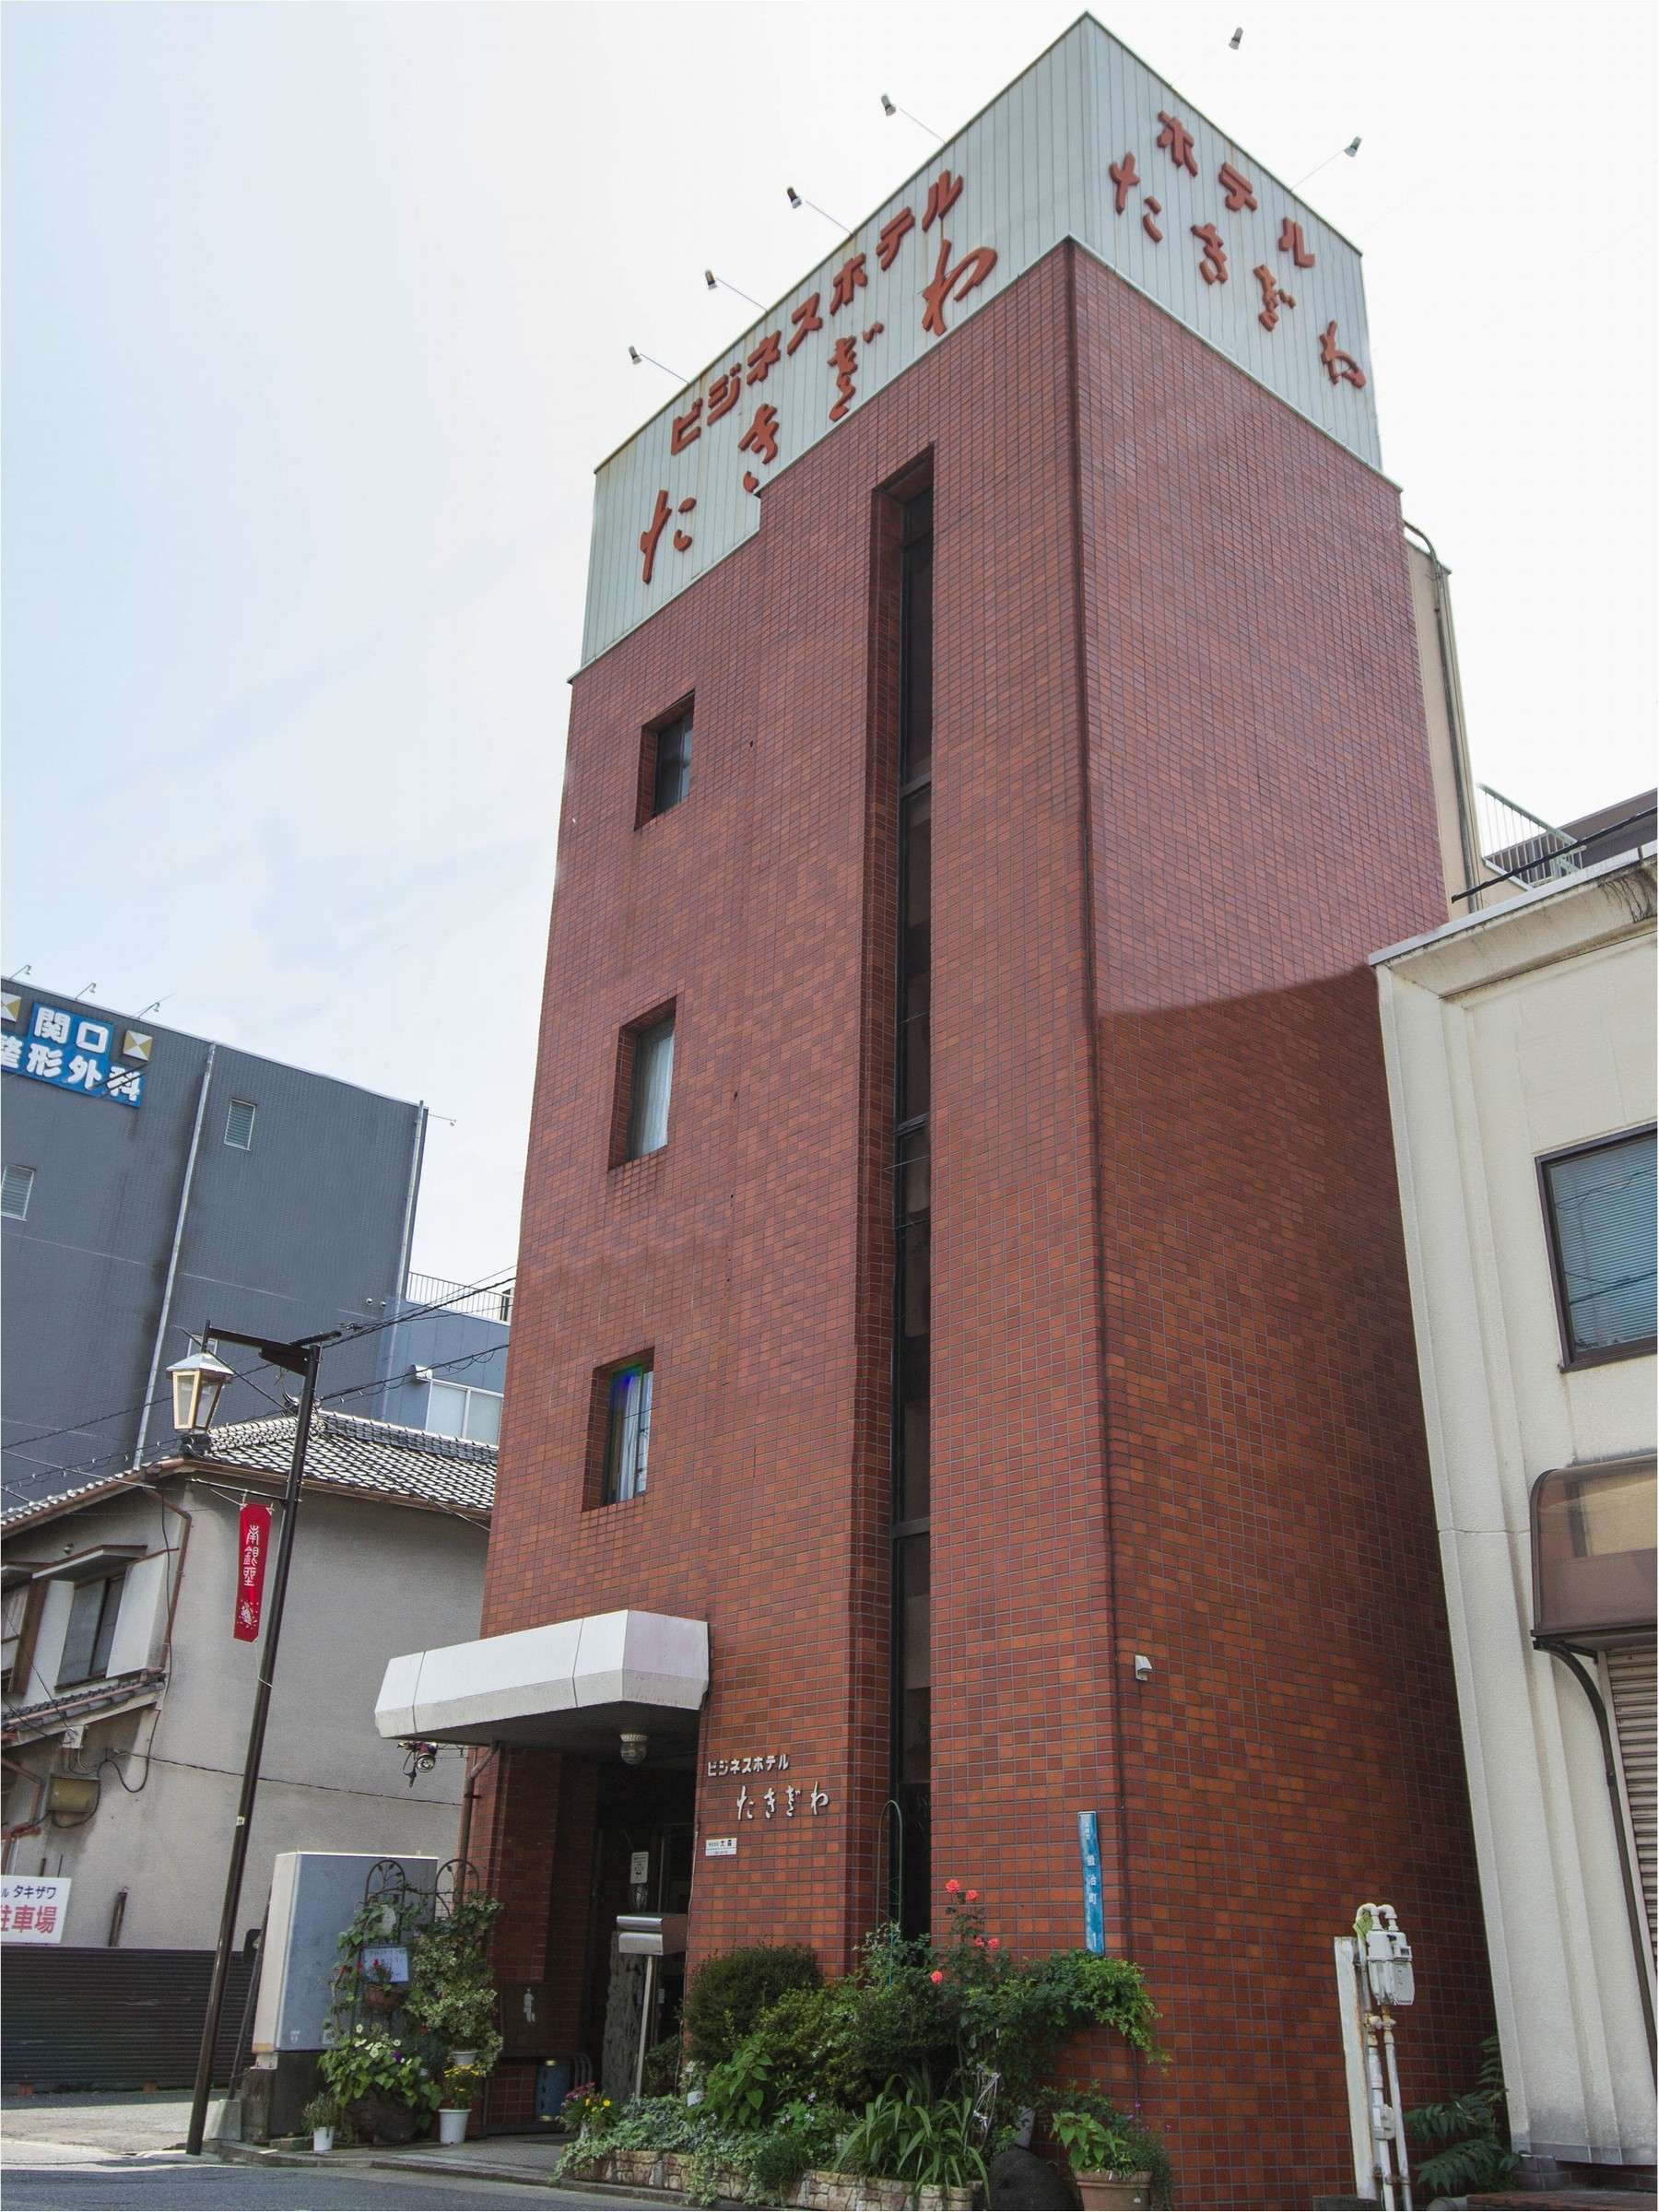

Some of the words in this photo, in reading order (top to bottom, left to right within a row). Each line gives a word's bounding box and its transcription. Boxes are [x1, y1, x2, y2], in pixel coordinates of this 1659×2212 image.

[1158, 110, 1315, 268] ホテル
[1110, 152, 1366, 389] たきざわ
[670, 170, 964, 455] ビジネスホテル
[640, 239, 997, 584] たきざわ
[34, 1006, 109, 1053] 関口
[1, 1033, 141, 1102] 整形外科
[707, 1753, 790, 1777] ビジネスホテル
[736, 1780, 830, 1821] たきざわ
[13, 1885, 57, 1900] タキザワ
